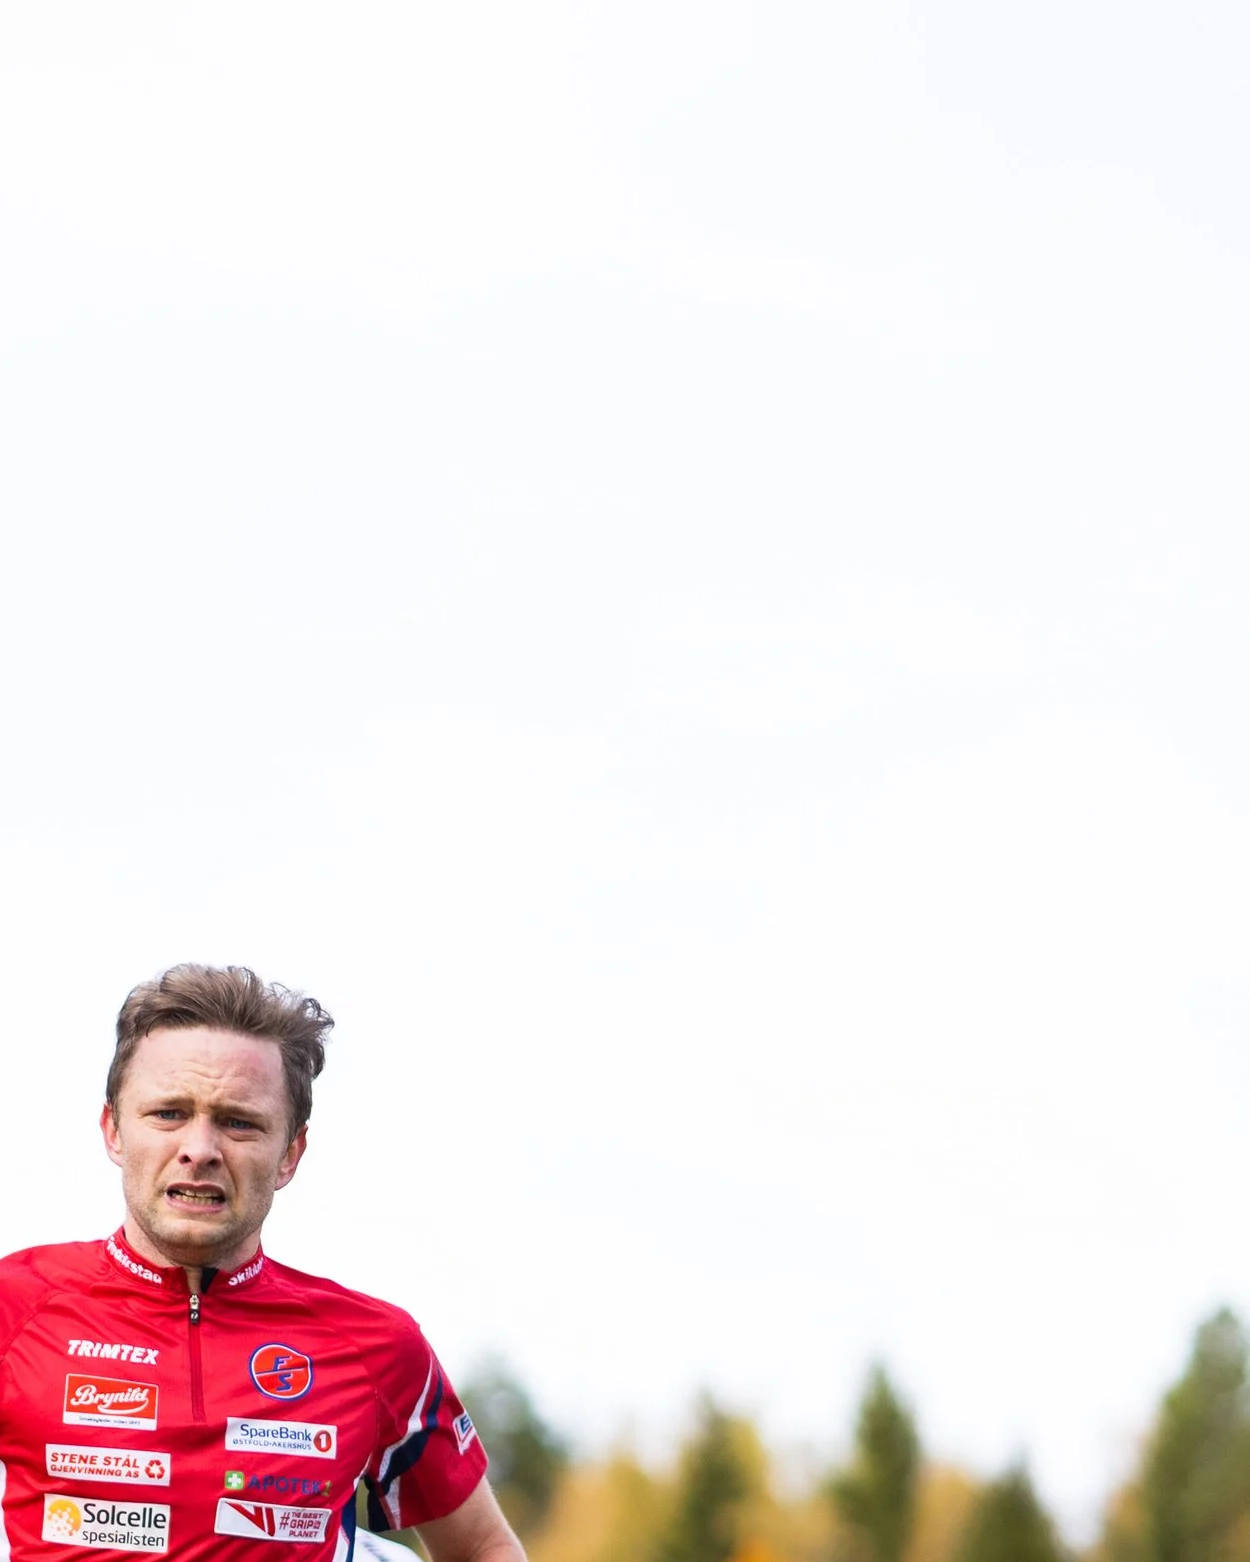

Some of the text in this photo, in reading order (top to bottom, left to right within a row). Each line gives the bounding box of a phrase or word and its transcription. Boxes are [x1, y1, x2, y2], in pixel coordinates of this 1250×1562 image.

[67, 1339, 159, 1365] TRIMTEX
[70, 1384, 150, 1415] Brynild
[240, 1423, 312, 1441] SpareBank
[51, 1452, 140, 1468] STENE STÅL
[50, 1464, 139, 1478] GJENVINNING AS
[248, 1474, 320, 1496] APOTEK
[83, 1502, 167, 1529] Solcelle
[290, 1519, 314, 1529] GRIP
[82, 1530, 165, 1547] spesialisten
